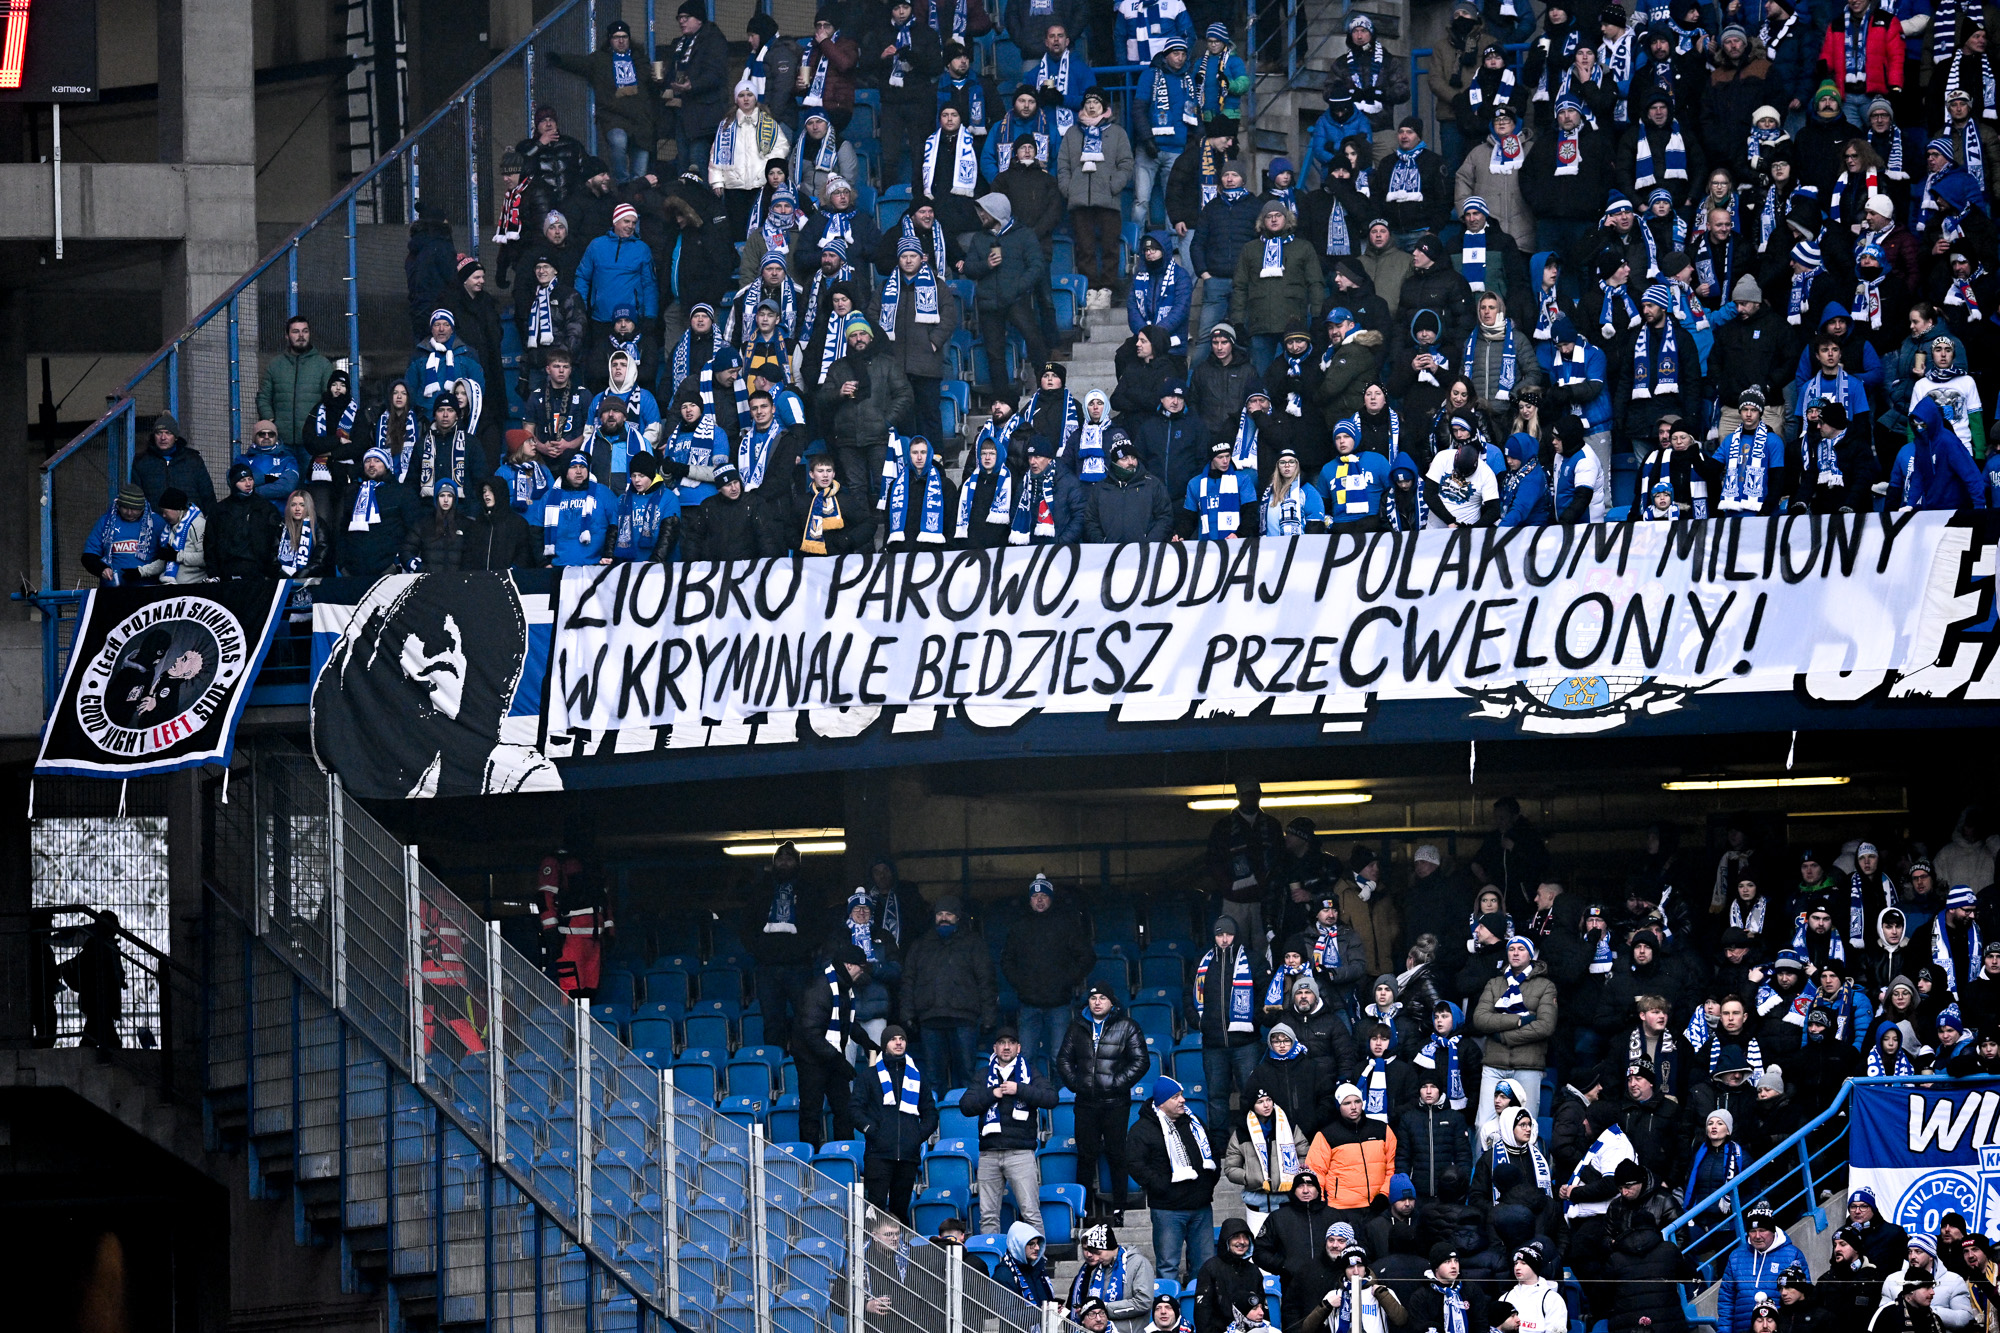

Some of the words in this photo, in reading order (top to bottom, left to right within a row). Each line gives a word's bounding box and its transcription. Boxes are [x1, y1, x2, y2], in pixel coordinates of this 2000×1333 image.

[1101, 535, 1300, 612] ODDAJ
[1316, 522, 1634, 602] POLAKOM
[1655, 513, 1918, 583] MILIONY
[95, 636, 123, 678] LECH
[121, 597, 186, 638] POZNAŃ
[187, 601, 241, 664] SKINHEADS
[558, 643, 608, 720] W
[618, 631, 899, 719] KRYMINALE
[80, 694, 108, 733] GOOD
[98, 726, 148, 753] NIGHT
[152, 714, 194, 750] LEFT
[192, 681, 228, 722] SIDE
[1908, 1091, 2000, 1152] WI
